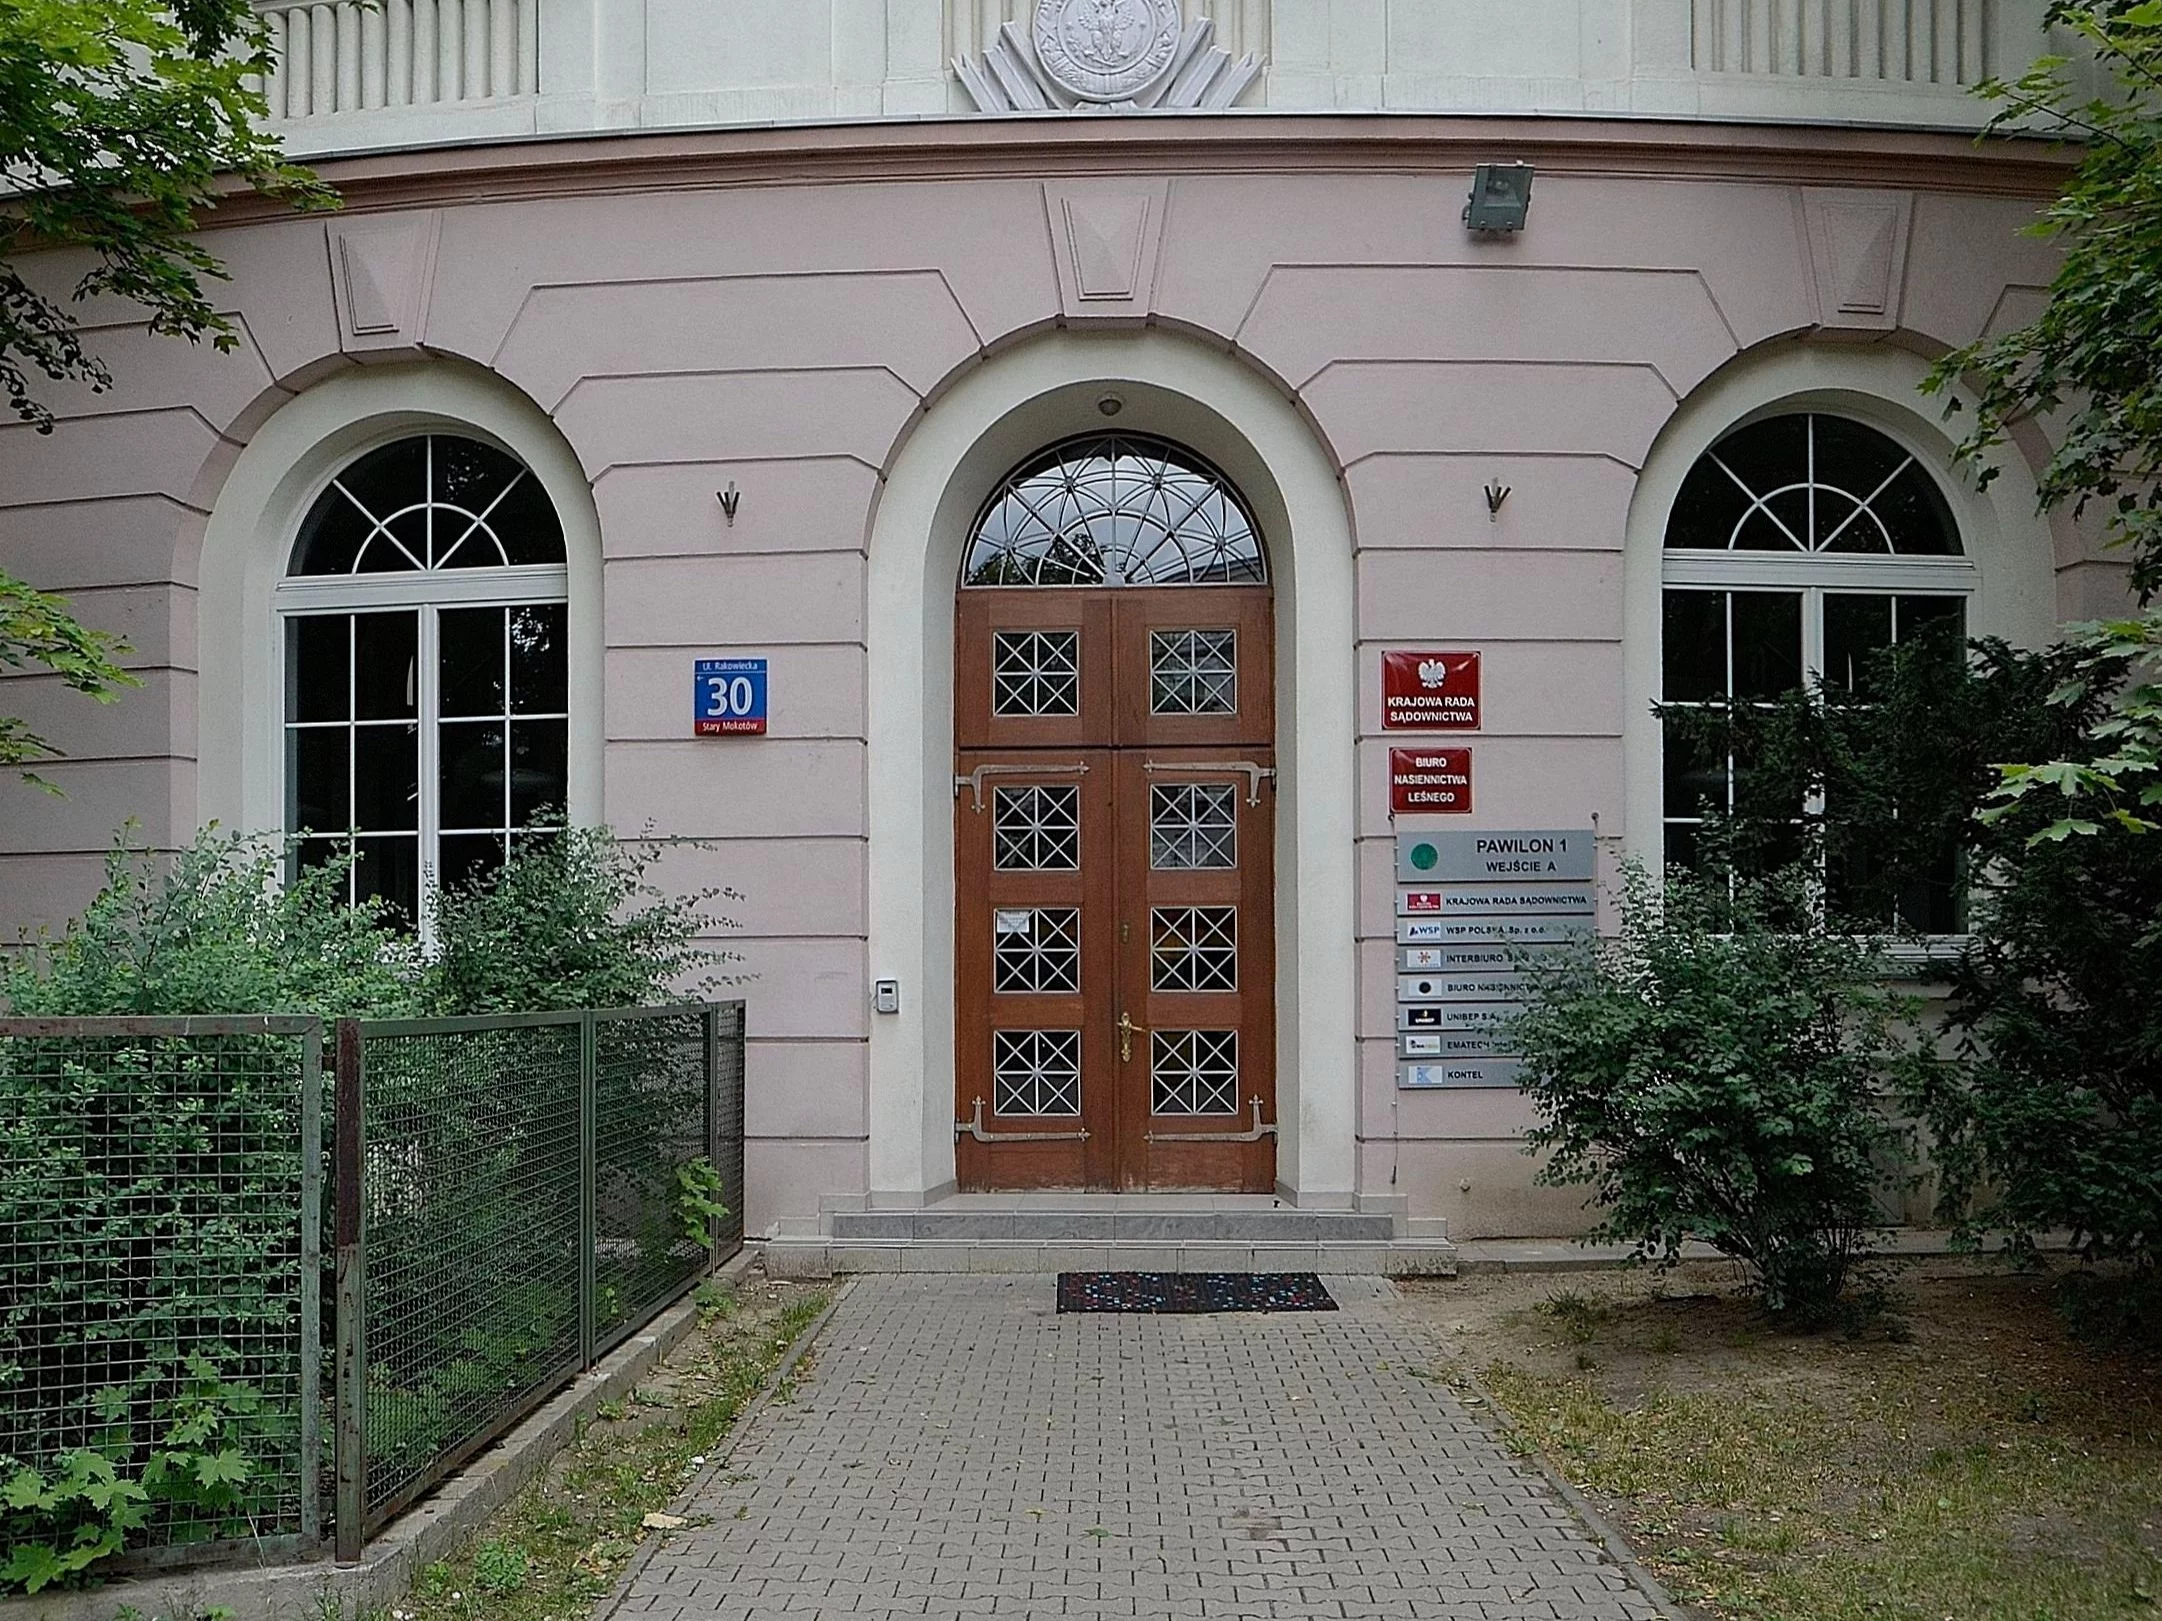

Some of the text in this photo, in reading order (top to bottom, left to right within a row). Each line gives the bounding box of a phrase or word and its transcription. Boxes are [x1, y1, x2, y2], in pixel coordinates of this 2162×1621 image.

[715, 662, 758, 670] Rakowiecka
[708, 676, 753, 716] 30
[1388, 696, 1475, 708] KRAJOWA RADA
[1390, 711, 1473, 724] SĄDOWNICTWA
[703, 721, 758, 732] Stary Mokotów
[1415, 757, 1447, 768] BIURO
[1394, 774, 1468, 785] NASIENNICTWA
[1407, 790, 1456, 803] LEŚNEGO
[1476, 838, 1568, 853] PAWILON 1
[1486, 860, 1557, 873] WEJŚCIE A
[1446, 897, 1490, 906] KRAJOWA
[1492, 897, 1518, 906] RADA
[1519, 896, 1587, 907] SĄDOWNICTWA
[1418, 926, 1440, 935] WSP
[1446, 926, 1466, 935] WSP
[1446, 954, 1504, 963] INTERBIURO
[1447, 983, 1476, 992] BIURO
[1446, 1012, 1480, 1021] UNIBEP
[1447, 1070, 1484, 1080] KONTEL
